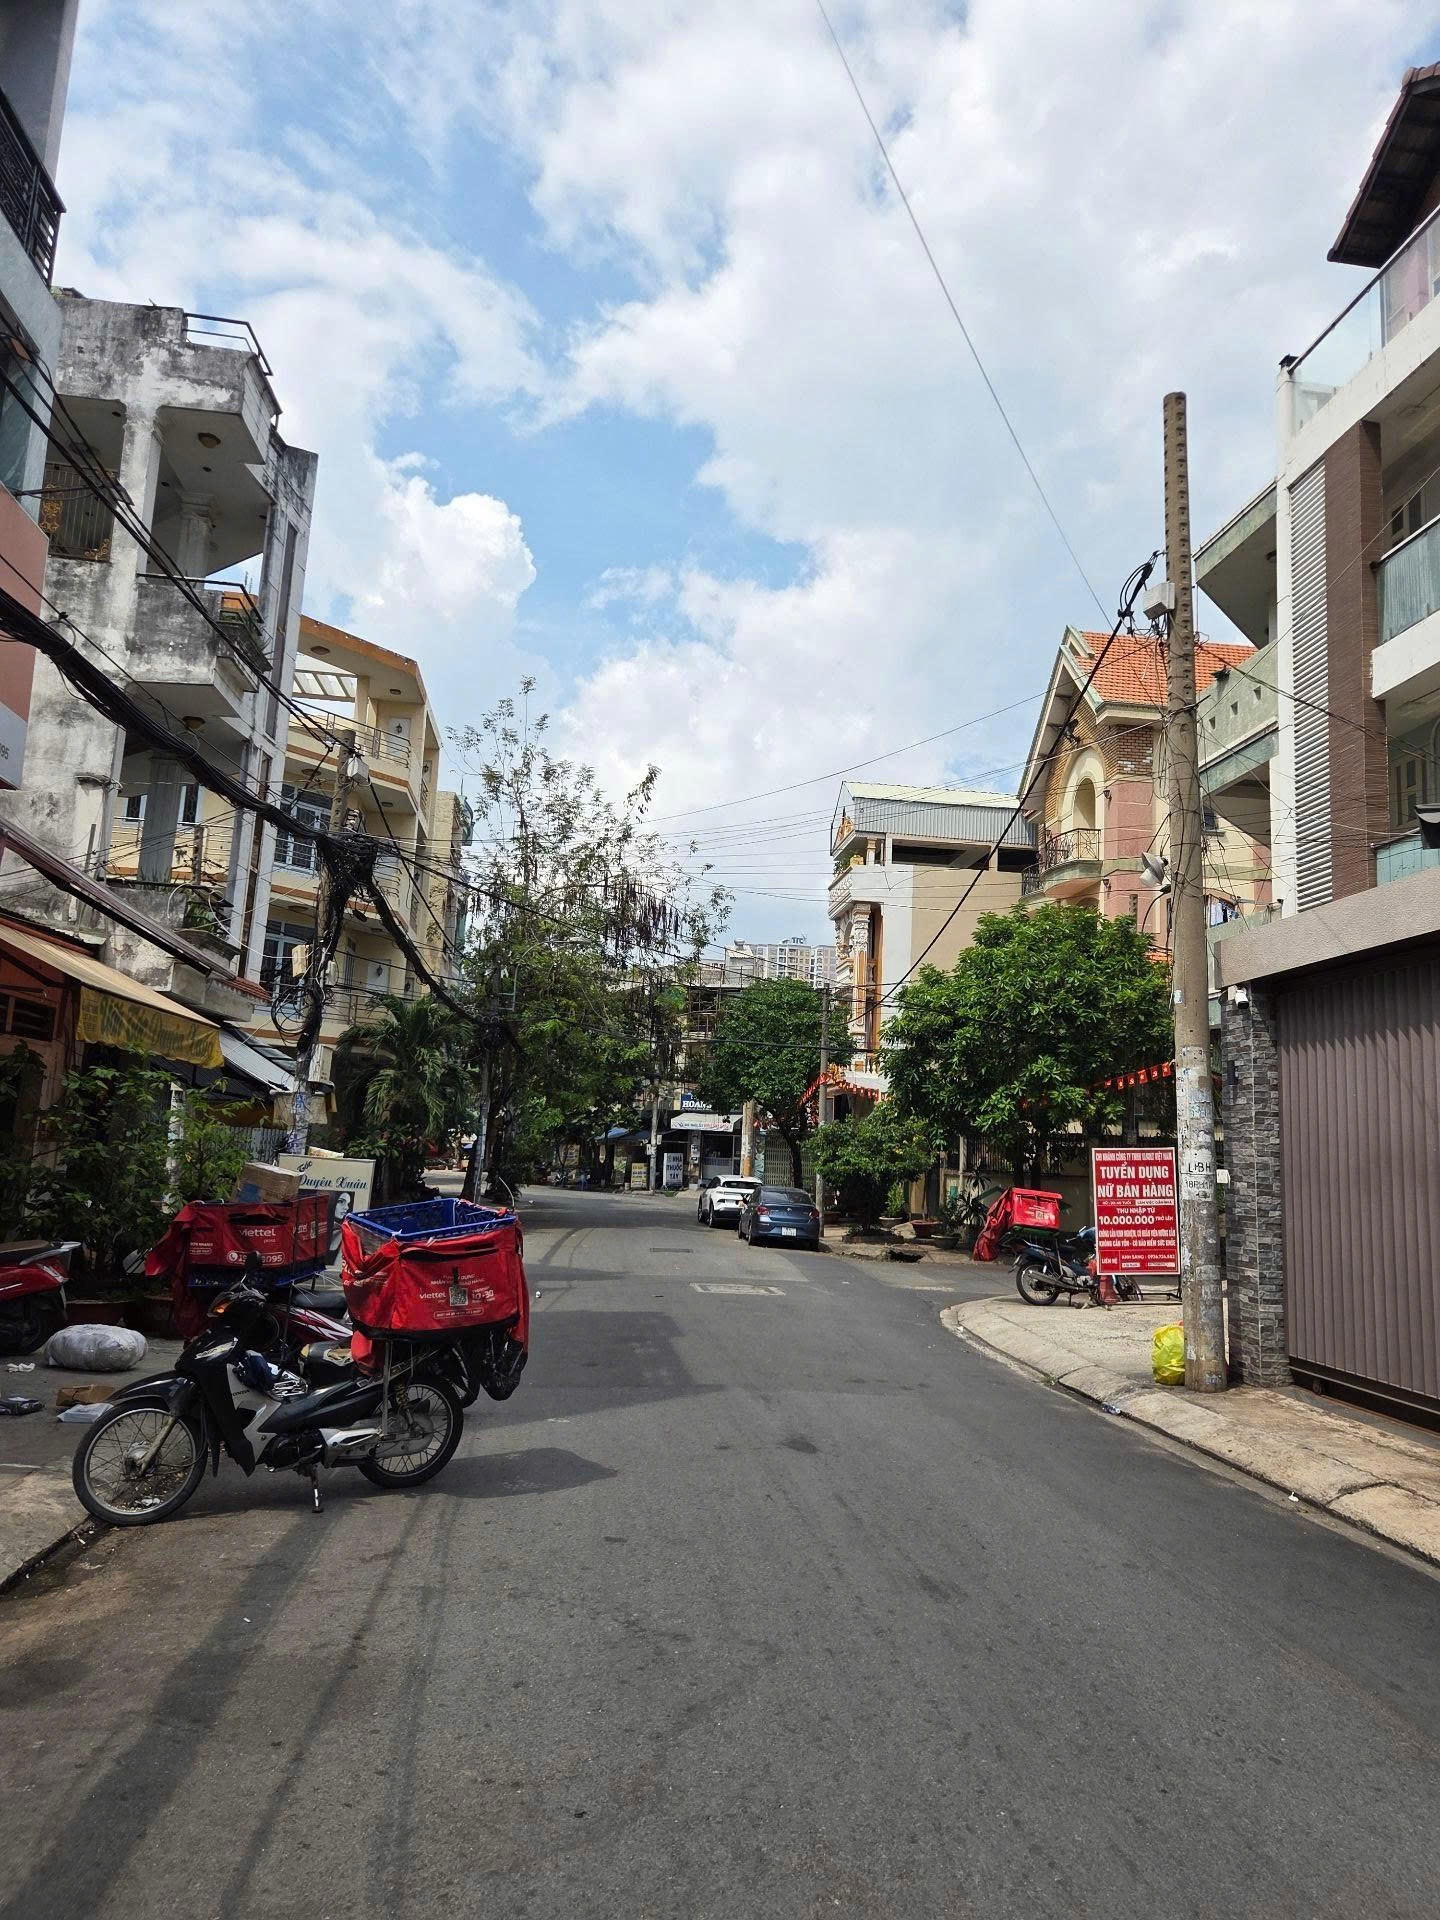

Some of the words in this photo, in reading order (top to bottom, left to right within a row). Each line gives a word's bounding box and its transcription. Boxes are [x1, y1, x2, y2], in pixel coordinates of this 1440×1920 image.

[1100, 1162, 1136, 1179] TUYỂN
[1138, 1166, 1169, 1182] DỤNG
[1098, 1184, 1114, 1198] NỮ
[1117, 1183, 1139, 1198] BÁN
[1142, 1182, 1173, 1198] HÀNG
[1130, 1206, 1146, 1215] NHẬP
[1099, 1215, 1155, 1225] 10.000.000
[240, 1228, 277, 1237] viettel
